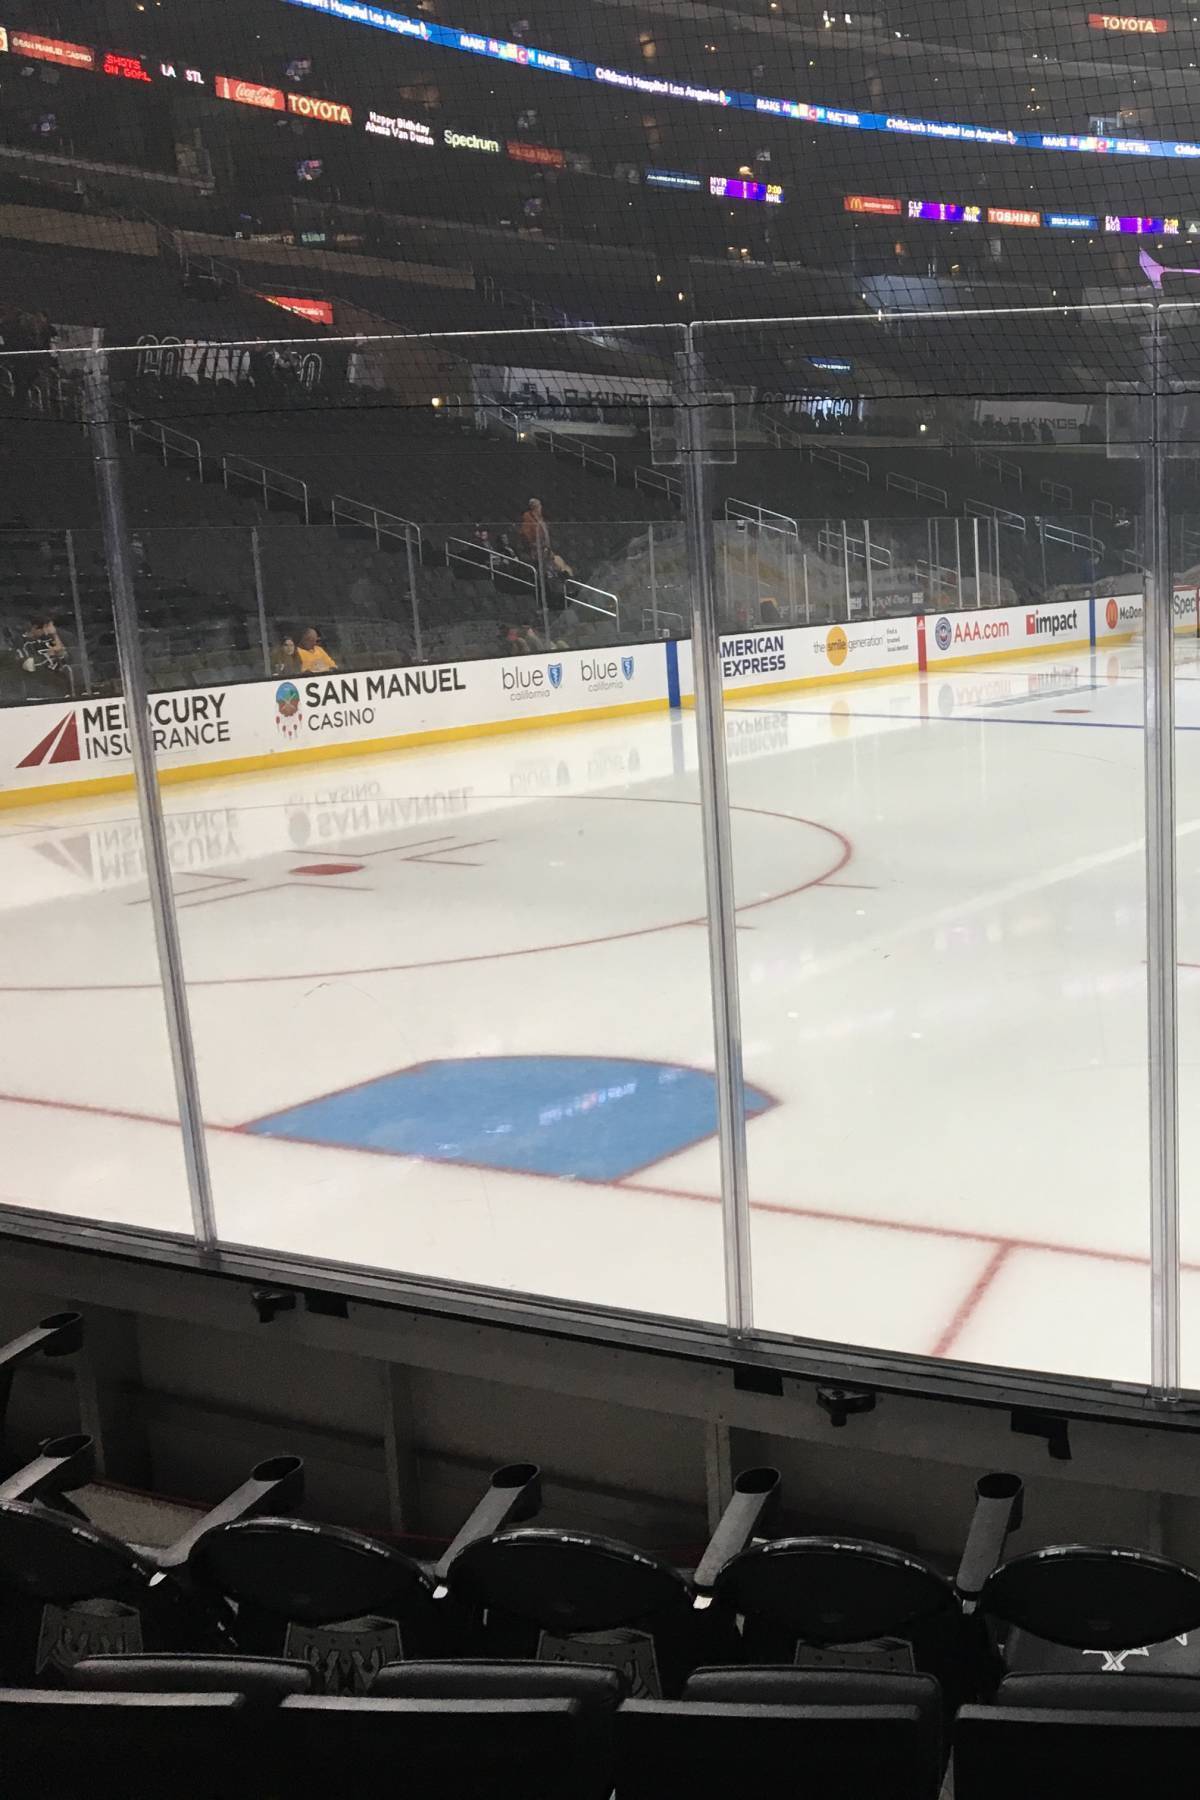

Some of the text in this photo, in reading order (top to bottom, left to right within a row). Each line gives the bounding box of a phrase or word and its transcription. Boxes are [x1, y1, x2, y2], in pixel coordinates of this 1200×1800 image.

[1102, 15, 1157, 34] TOYOTA
[105, 54, 142, 70] SHOTS
[161, 63, 177, 78] LA
[186, 69, 205, 84] STL
[288, 94, 353, 124] TOYOTA
[444, 130, 500, 153] Spectrum
[989, 209, 1040, 225] TOSHIBA
[954, 621, 1010, 643] AAA.com
[1035, 609, 1078, 637] impact
[812, 640, 826, 654] the
[826, 637, 848, 652] smile
[848, 635, 884, 652] generation
[580, 659, 618, 682] blue
[723, 654, 786, 678] EXPRESS
[305, 667, 467, 708] SAN MANUEL
[502, 666, 544, 690] blue
[588, 681, 624, 693] california
[510, 689, 551, 702] california
[308, 708, 375, 731] CASINO
